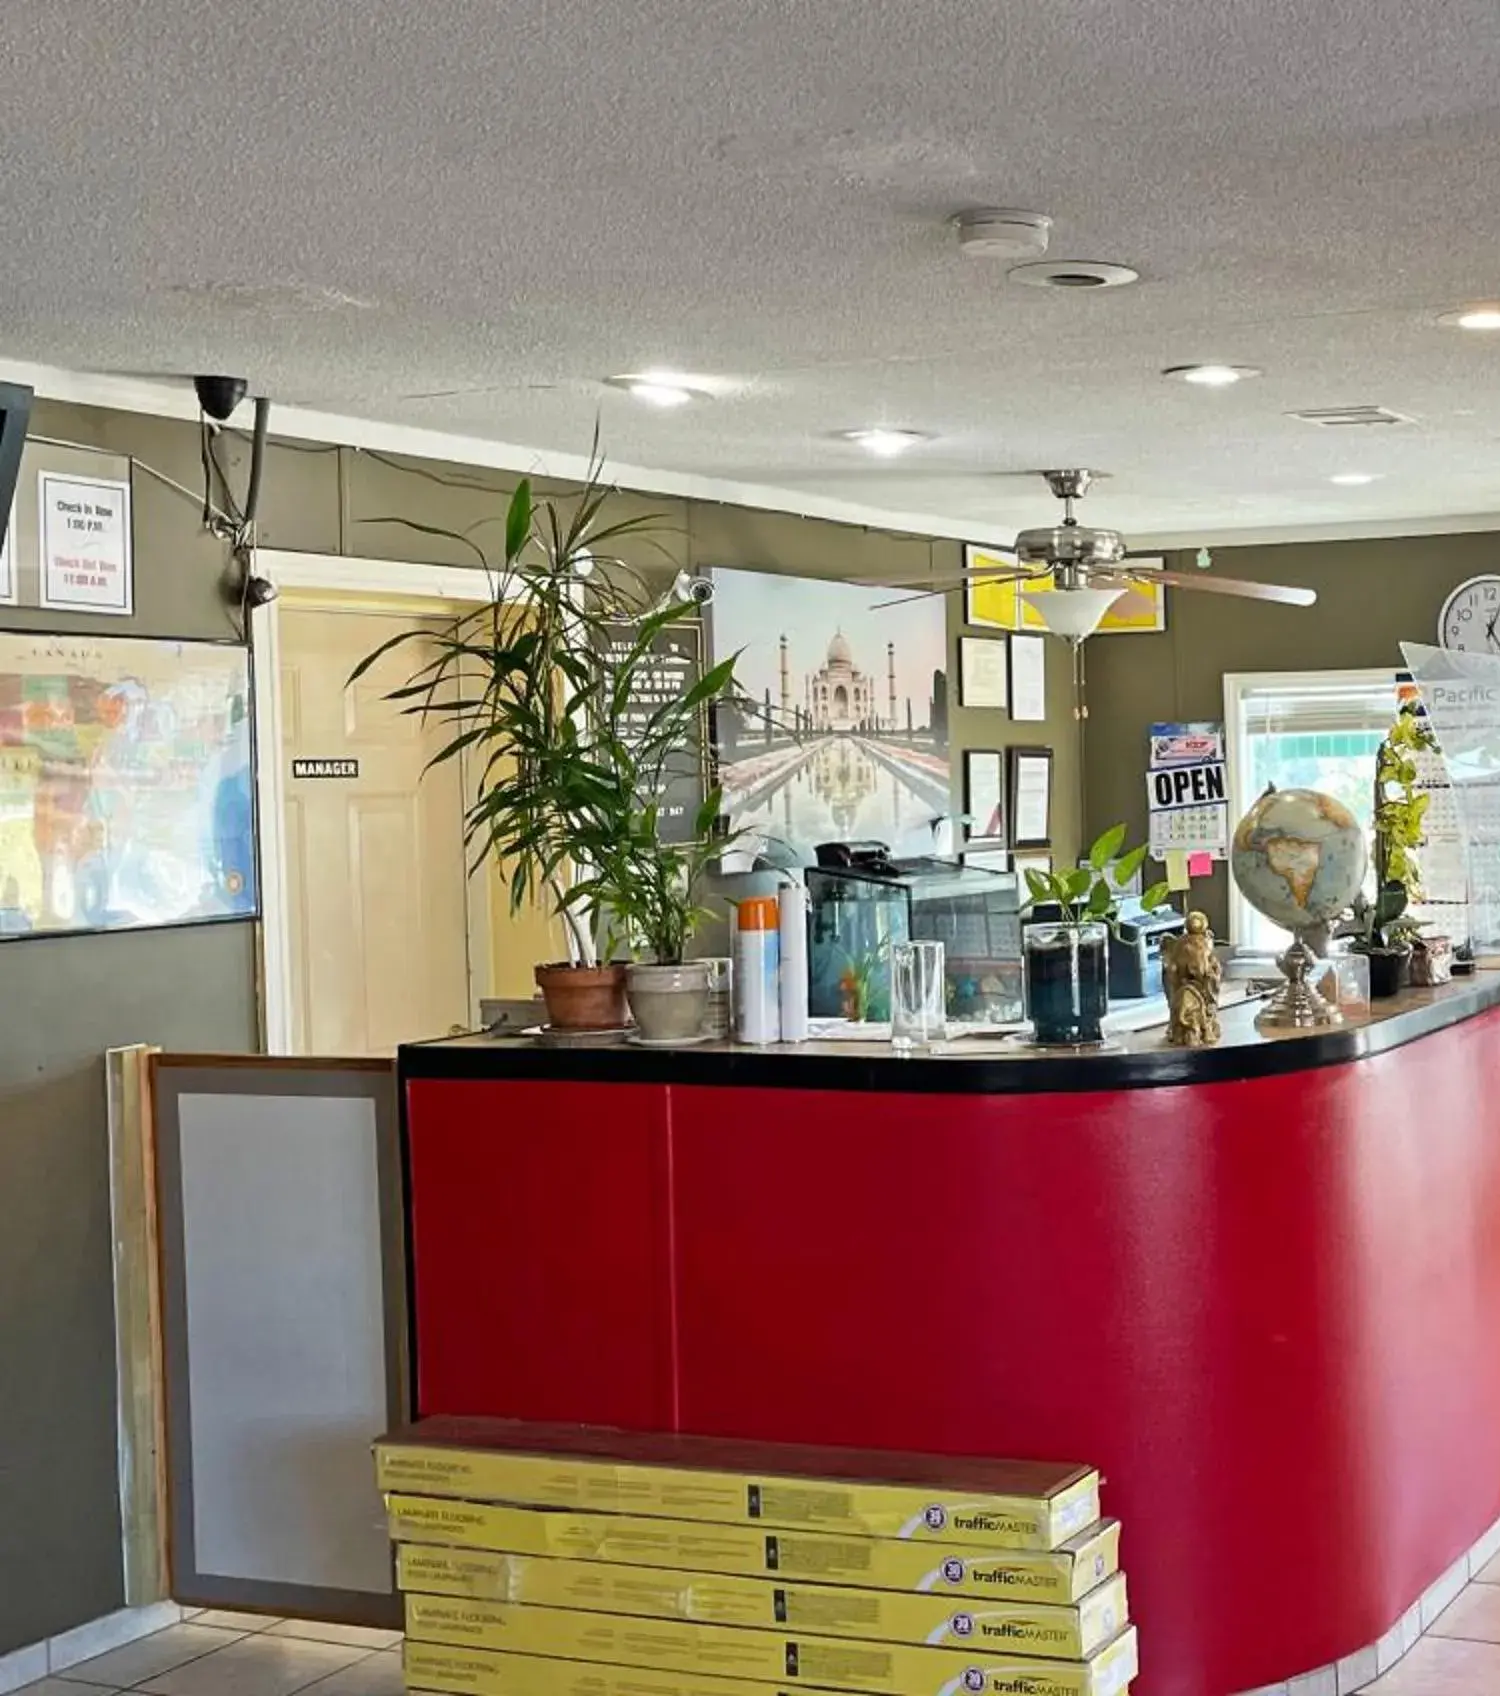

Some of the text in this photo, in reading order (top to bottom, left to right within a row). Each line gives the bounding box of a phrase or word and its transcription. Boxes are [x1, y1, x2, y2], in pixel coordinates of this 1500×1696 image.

[1484, 587, 1496, 600] 12
[1457, 608, 1472, 622] 10
[1451, 625, 1459, 637] 9
[1434, 686, 1494, 703] Pacific
[295, 761, 356, 776] MANAGER
[1155, 765, 1225, 806] OPEN
